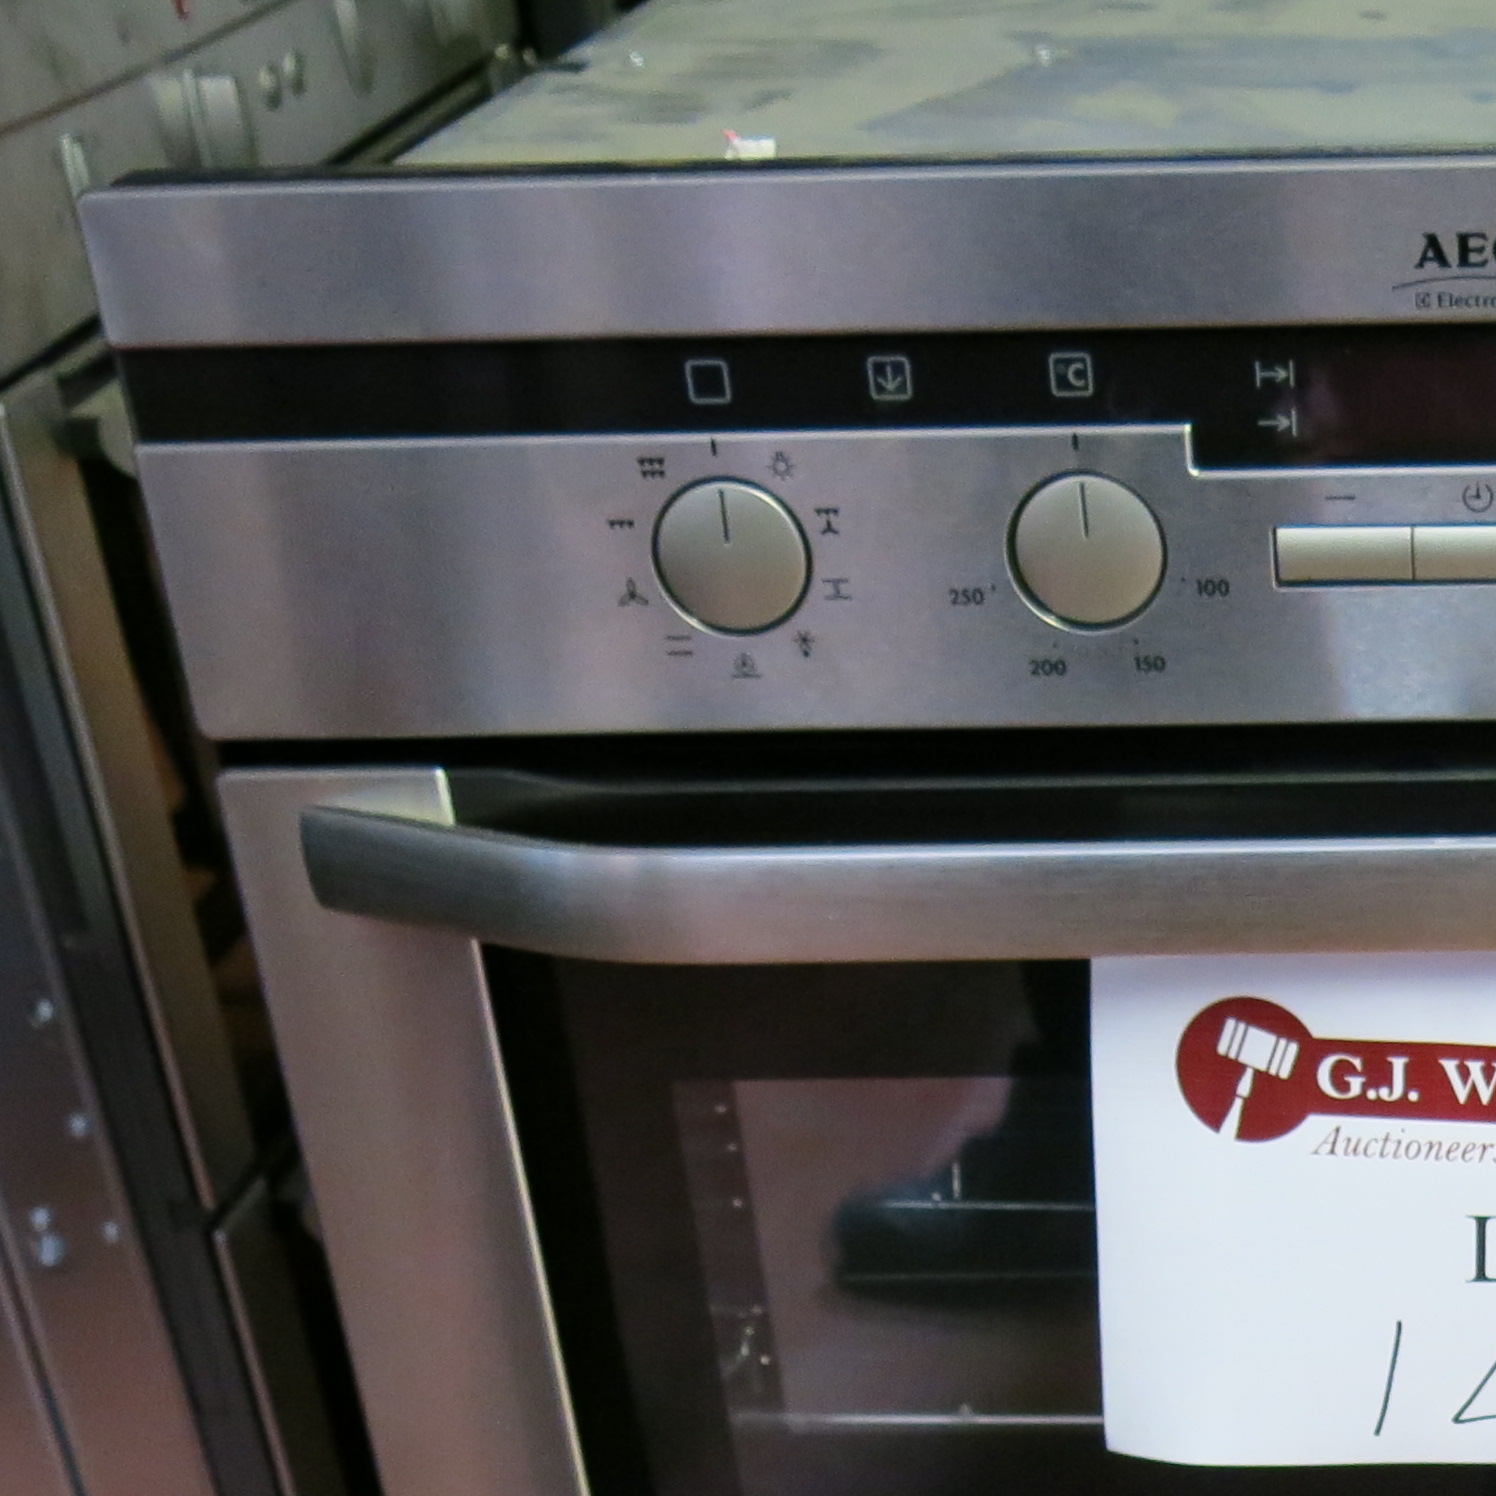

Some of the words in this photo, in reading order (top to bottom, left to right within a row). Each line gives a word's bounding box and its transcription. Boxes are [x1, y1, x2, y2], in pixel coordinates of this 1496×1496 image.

[948, 588, 985, 606] 250
[1196, 578, 1230, 598] 100
[1030, 658, 1068, 678] 200
[1134, 655, 1167, 674] 150
[1316, 1054, 1420, 1105] G.J.
